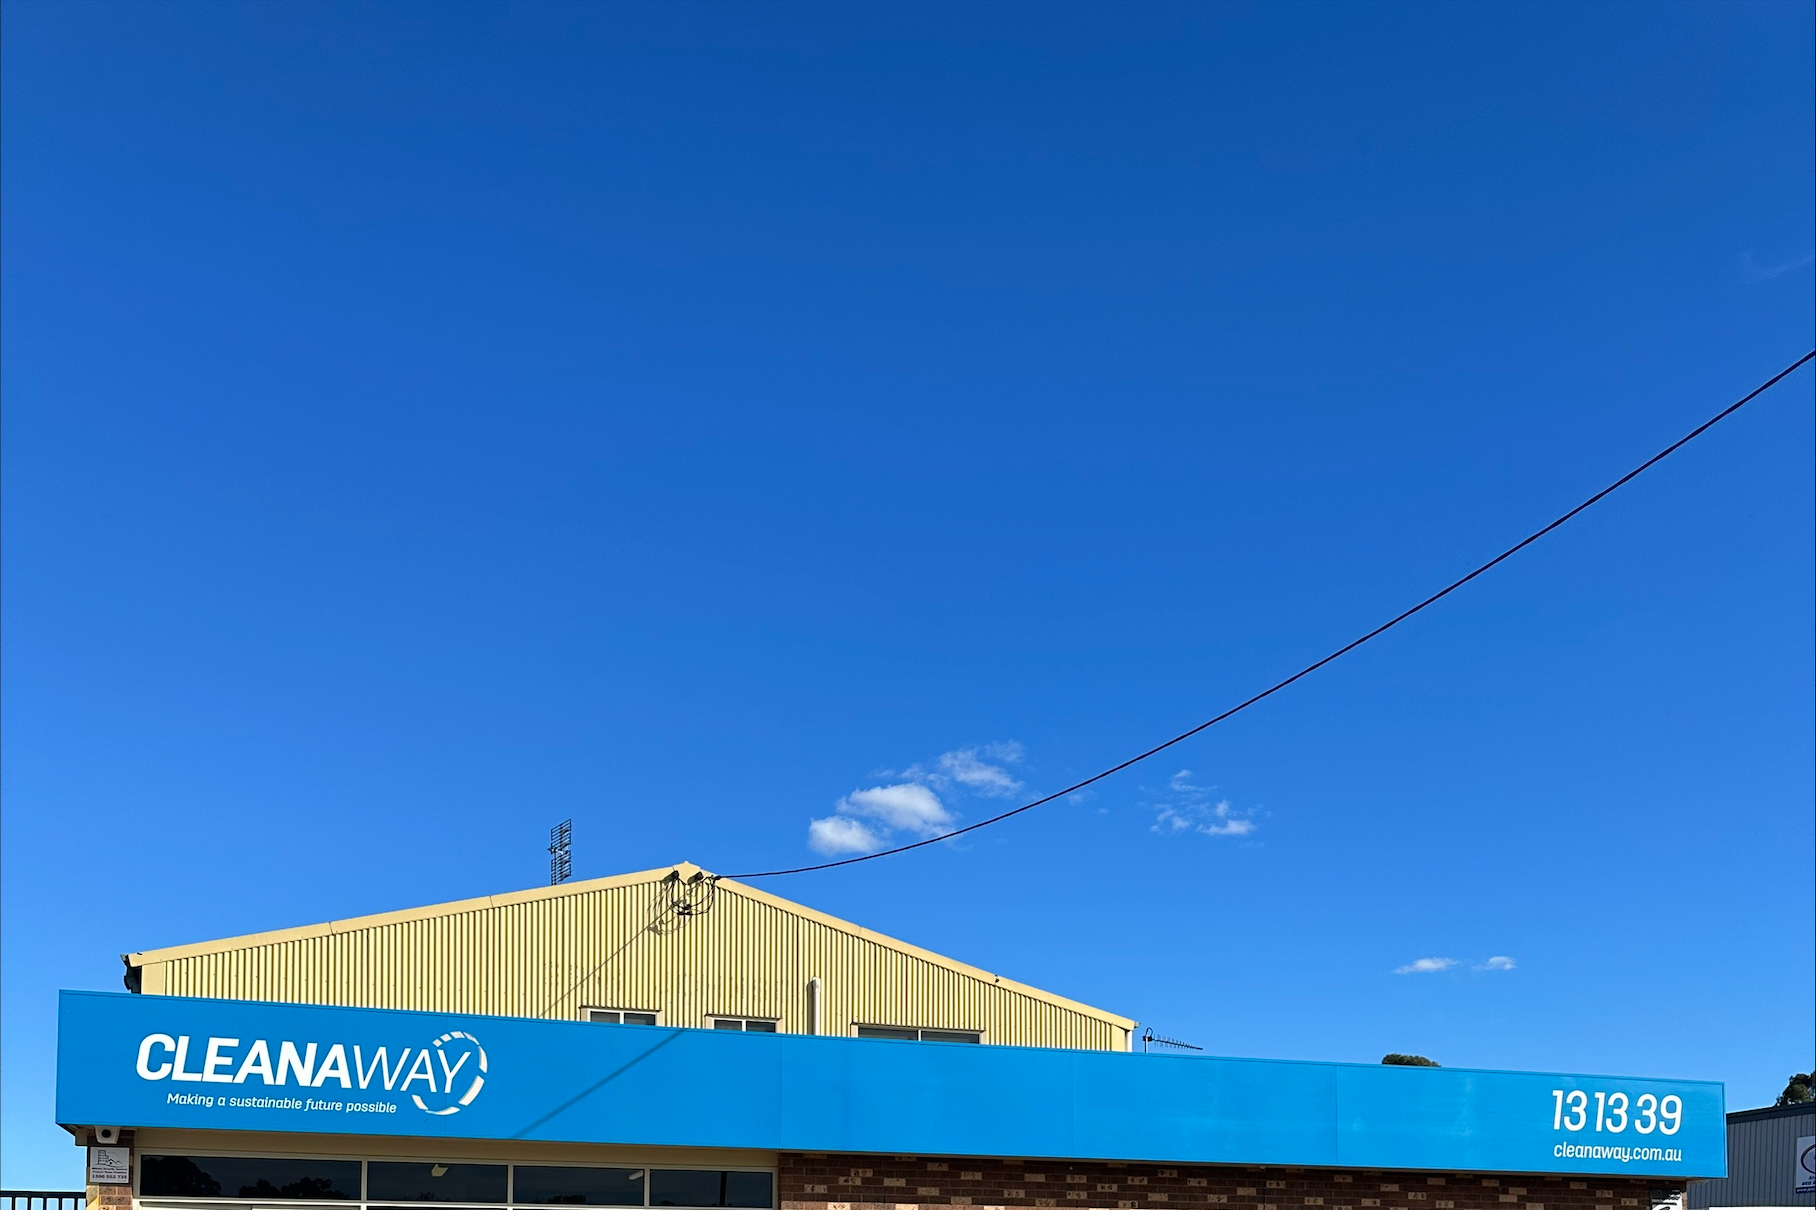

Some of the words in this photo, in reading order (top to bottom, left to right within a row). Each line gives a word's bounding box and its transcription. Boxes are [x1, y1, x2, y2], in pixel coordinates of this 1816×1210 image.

[136, 1033, 471, 1093] CLEANAWAY
[166, 1093, 214, 1108] Making
[217, 1097, 226, 1106] a
[229, 1096, 302, 1110] sustainable
[303, 1098, 343, 1111] future
[346, 1100, 397, 1113] possible
[1552, 1089, 1588, 1131] 13
[1594, 1092, 1629, 1133] 13
[1634, 1093, 1683, 1135] 39
[1553, 1141, 1682, 1163] cleanaway.com.au
